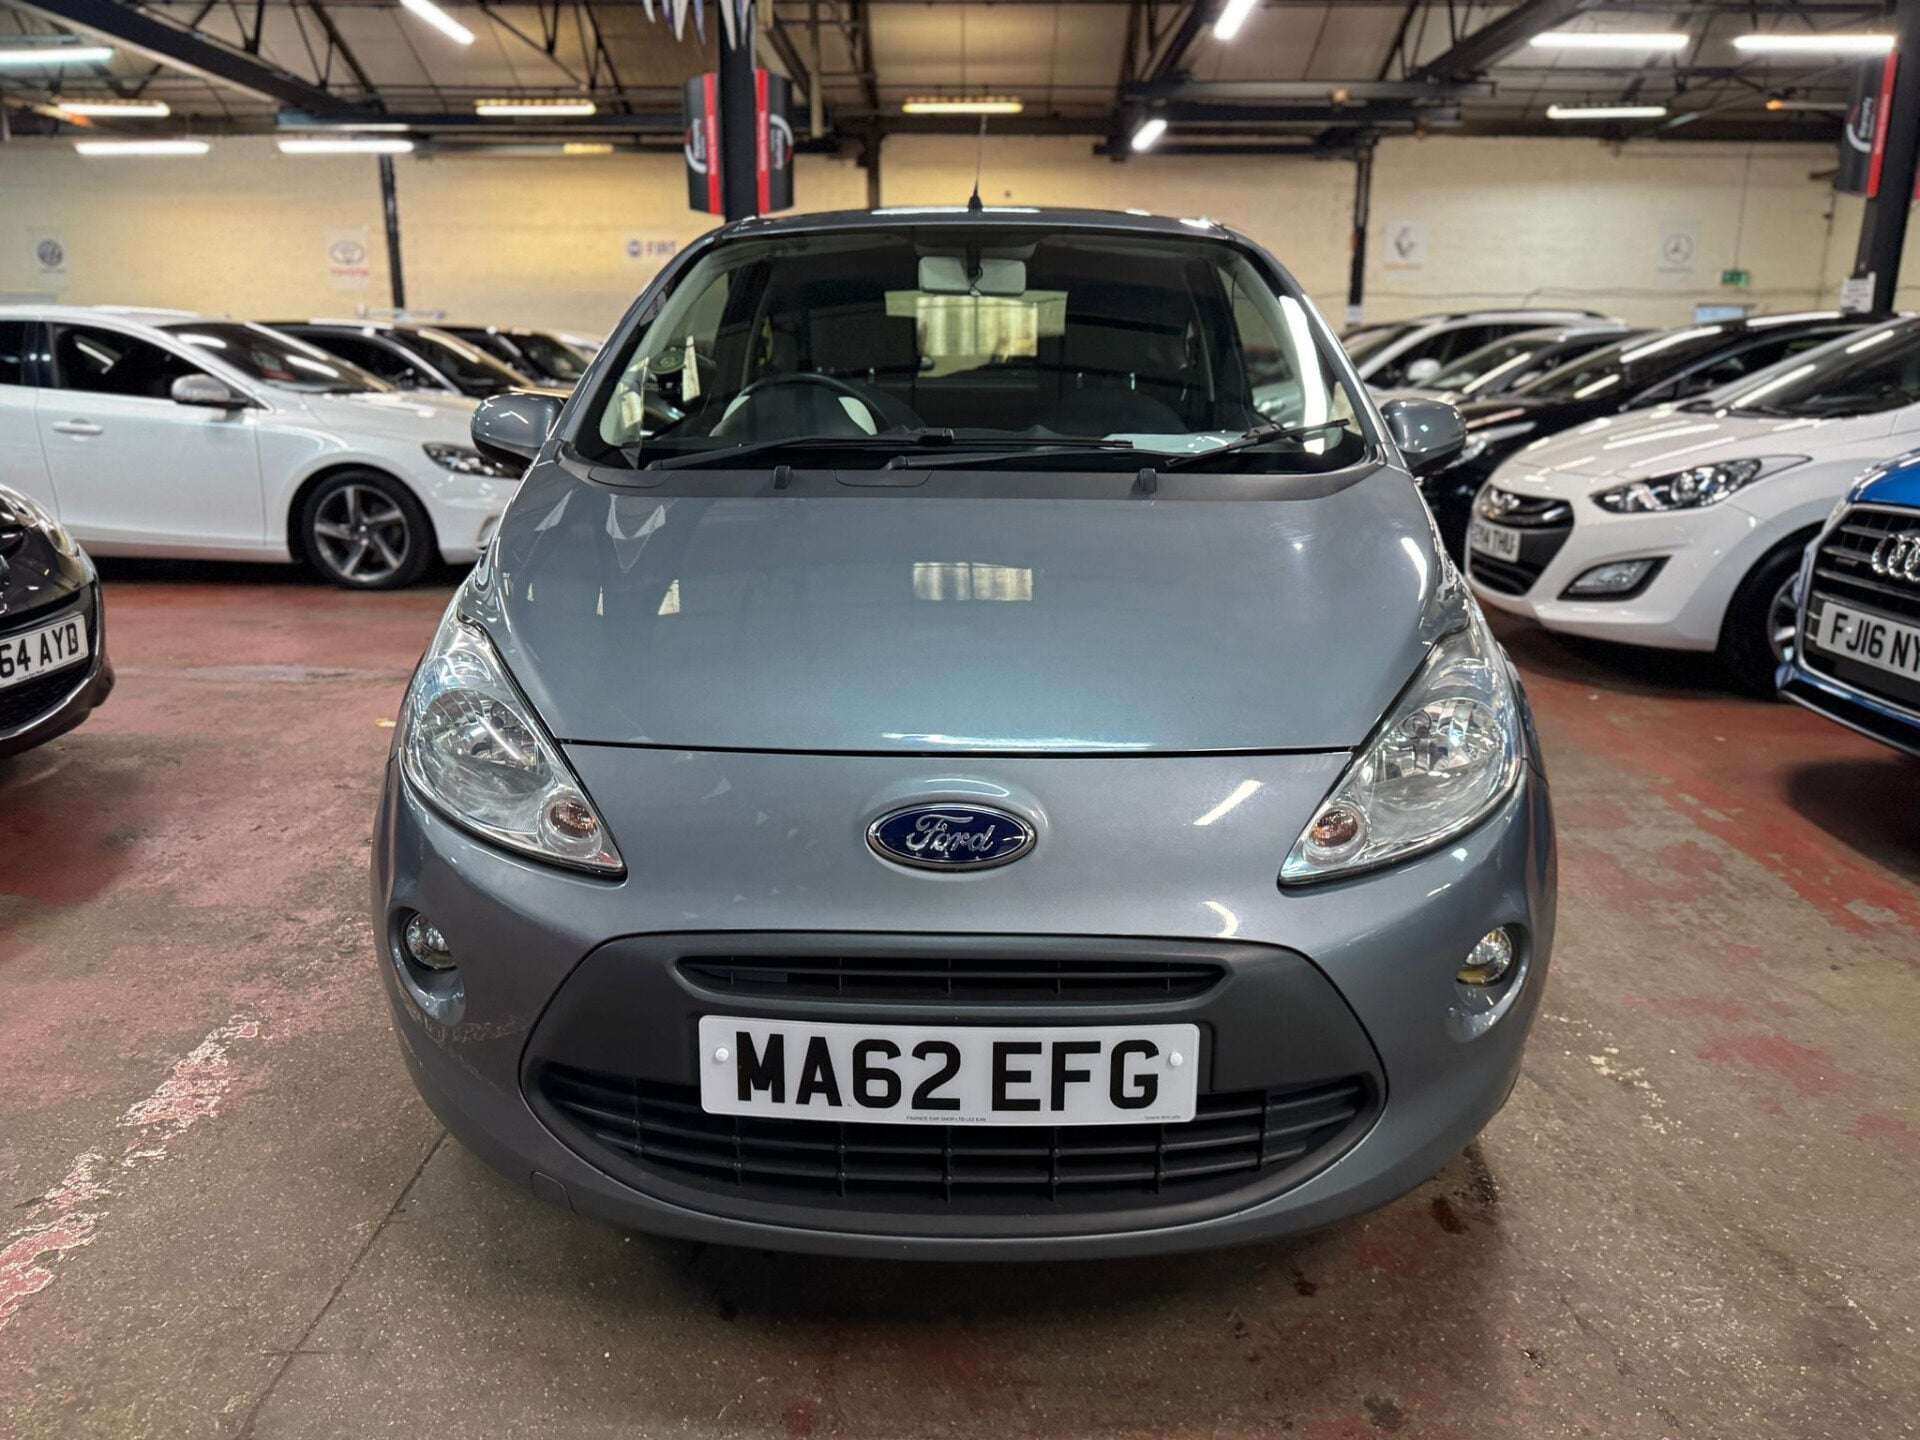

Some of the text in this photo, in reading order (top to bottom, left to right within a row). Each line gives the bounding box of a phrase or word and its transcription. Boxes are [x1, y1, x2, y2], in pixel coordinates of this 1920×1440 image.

[40, 622, 79, 666] AYD
[1830, 612, 1886, 659] FJ16
[906, 814, 995, 852] Ford
[736, 1031, 1159, 1111] MA62 EFG
